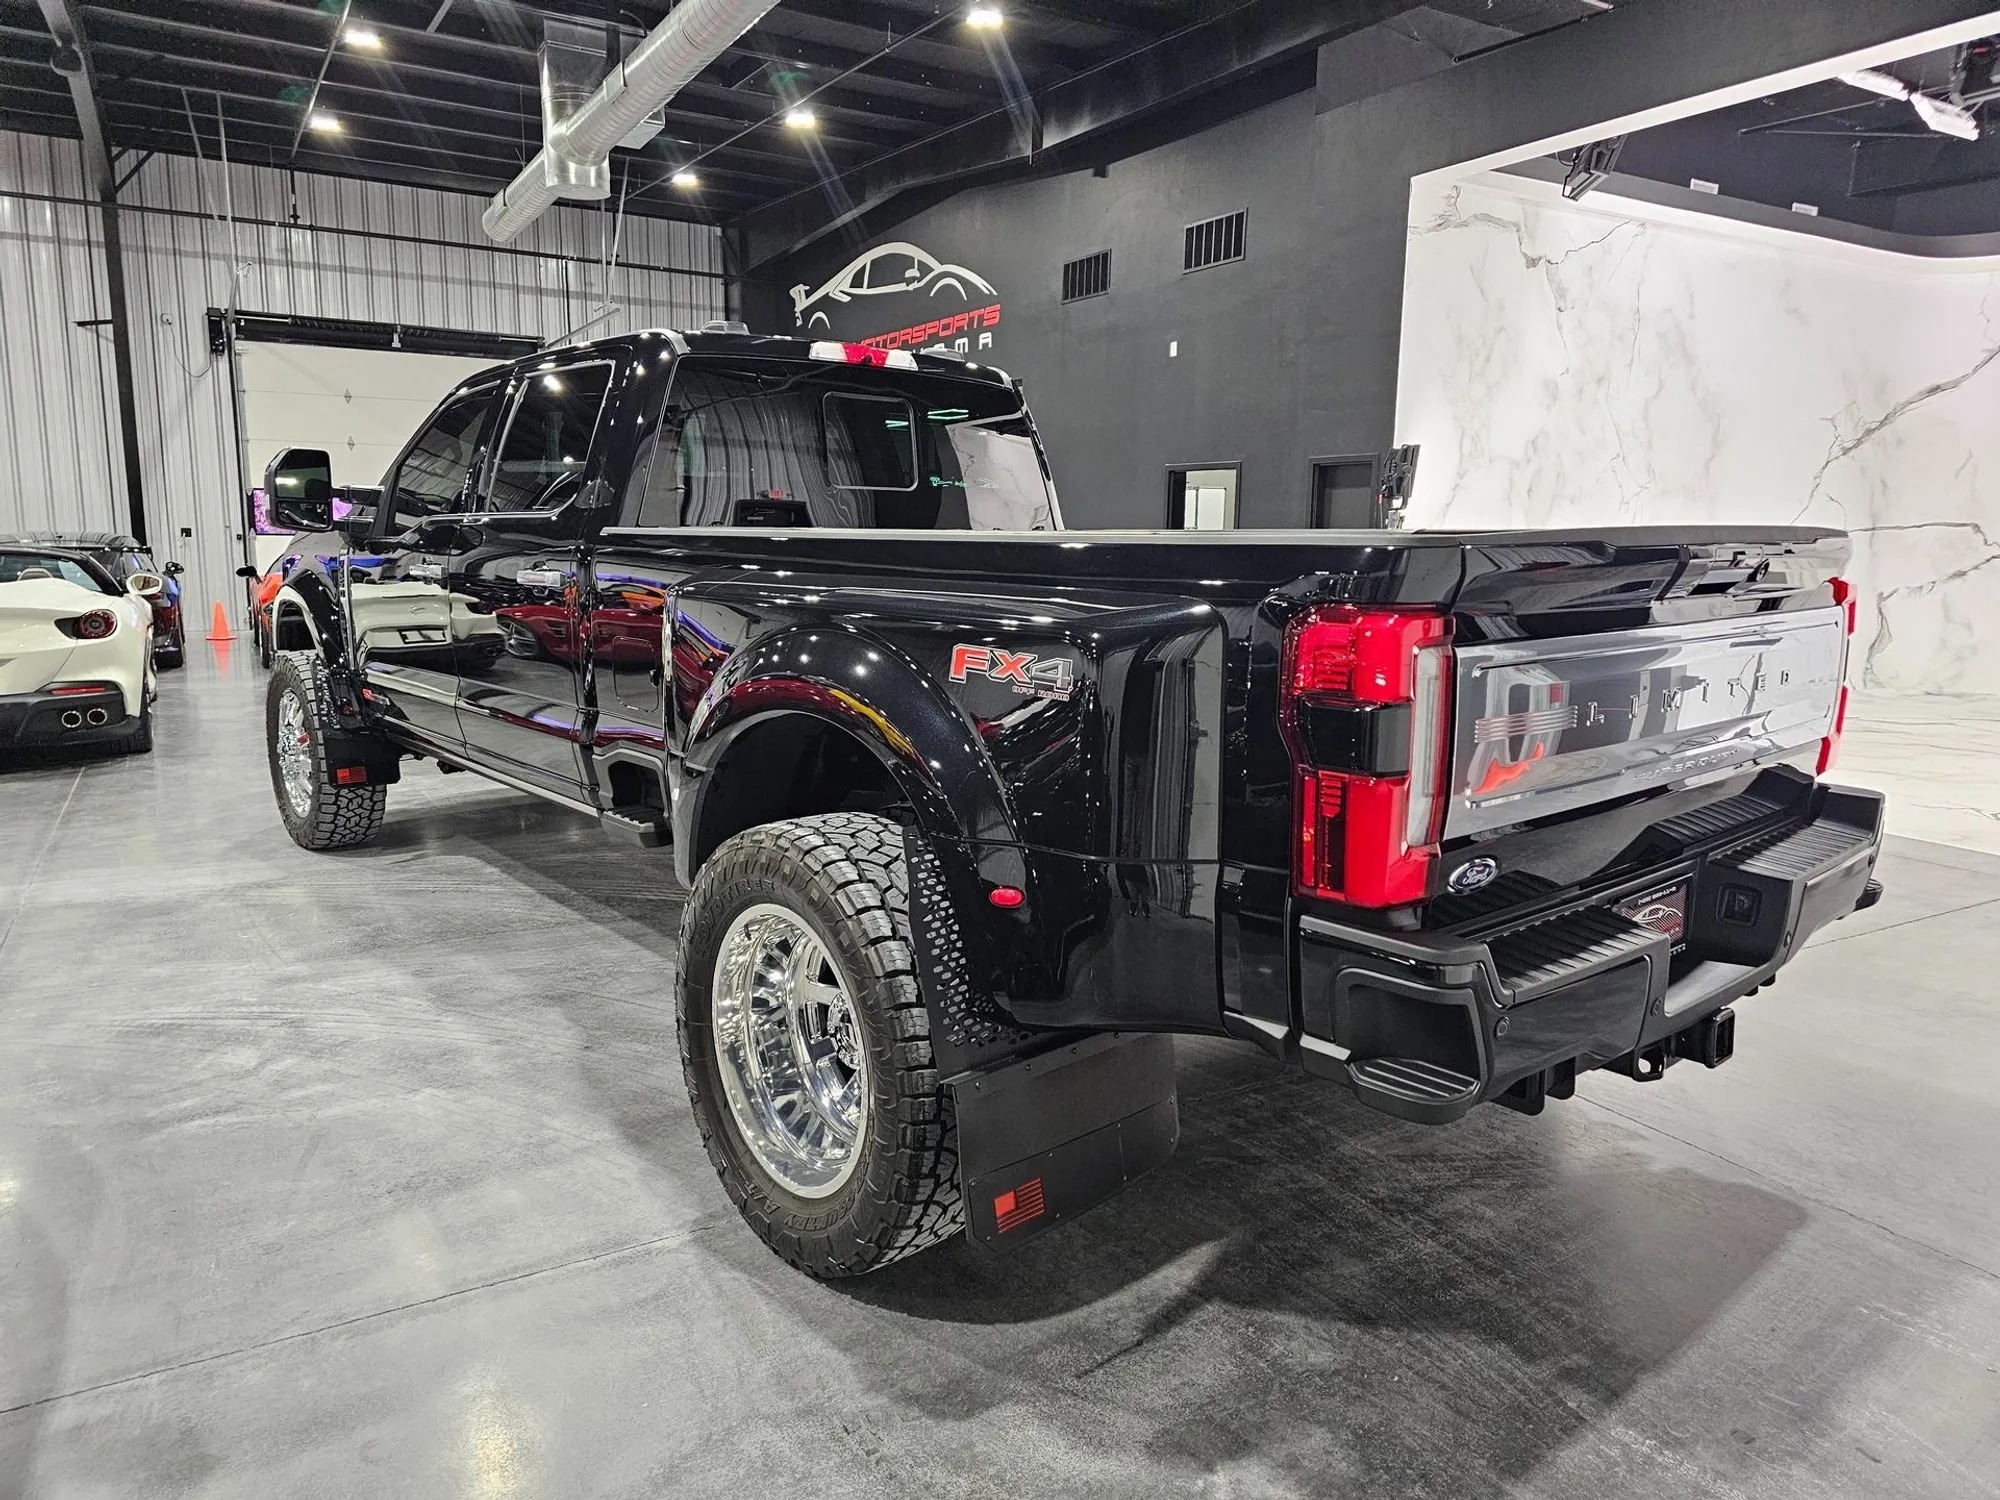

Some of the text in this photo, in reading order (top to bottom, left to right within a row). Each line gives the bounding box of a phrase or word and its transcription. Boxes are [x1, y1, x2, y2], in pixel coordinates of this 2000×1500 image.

[857, 304, 1001, 349] OTORSPORTS
[949, 643, 1073, 693] FX4
[1586, 670, 1791, 727] LIMITED
